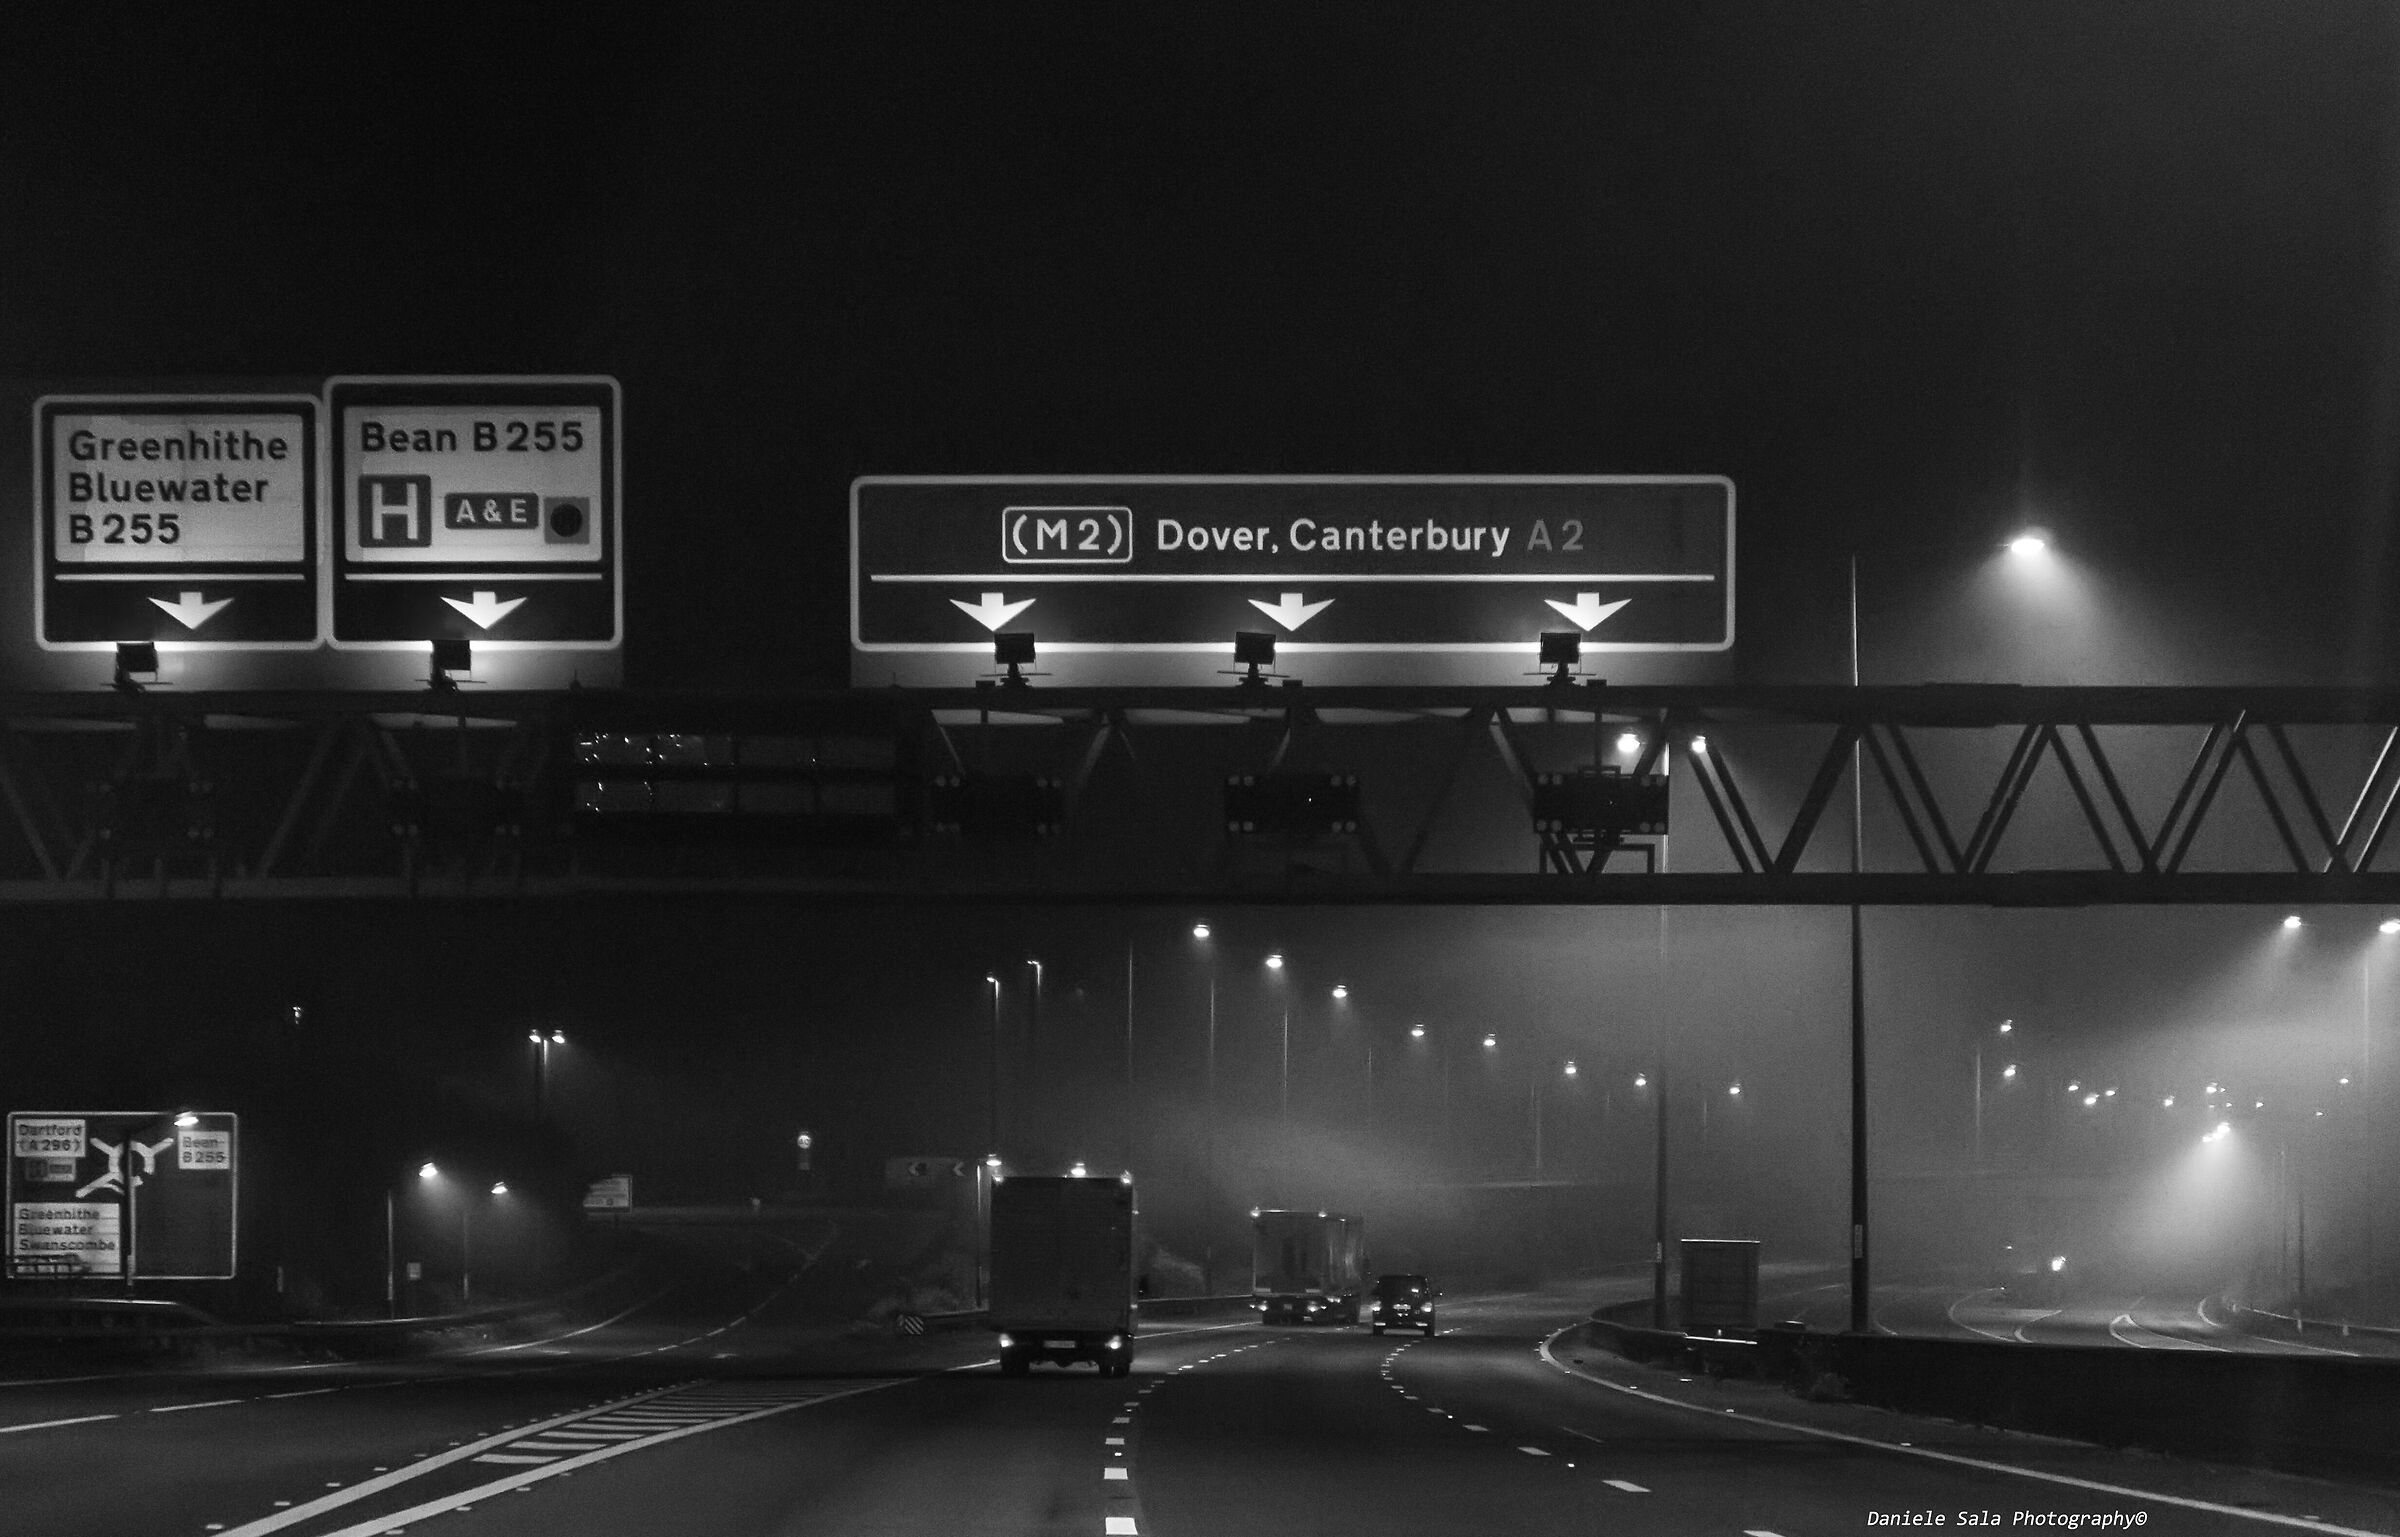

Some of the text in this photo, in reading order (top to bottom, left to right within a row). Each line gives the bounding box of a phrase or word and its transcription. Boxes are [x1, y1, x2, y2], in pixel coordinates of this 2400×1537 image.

[68, 429, 288, 461] Greenhithe
[361, 421, 457, 452] Bean
[69, 472, 269, 502] Bluewater
[371, 482, 418, 540] H
[1157, 518, 1279, 554] Dover,
[1289, 517, 1510, 557] Canterbury
[1526, 518, 1584, 552] A2
[19, 1124, 81, 1136] Dartford
[20, 1208, 100, 1220] Greenhithe
[20, 1239, 115, 1251] Swanscombe
